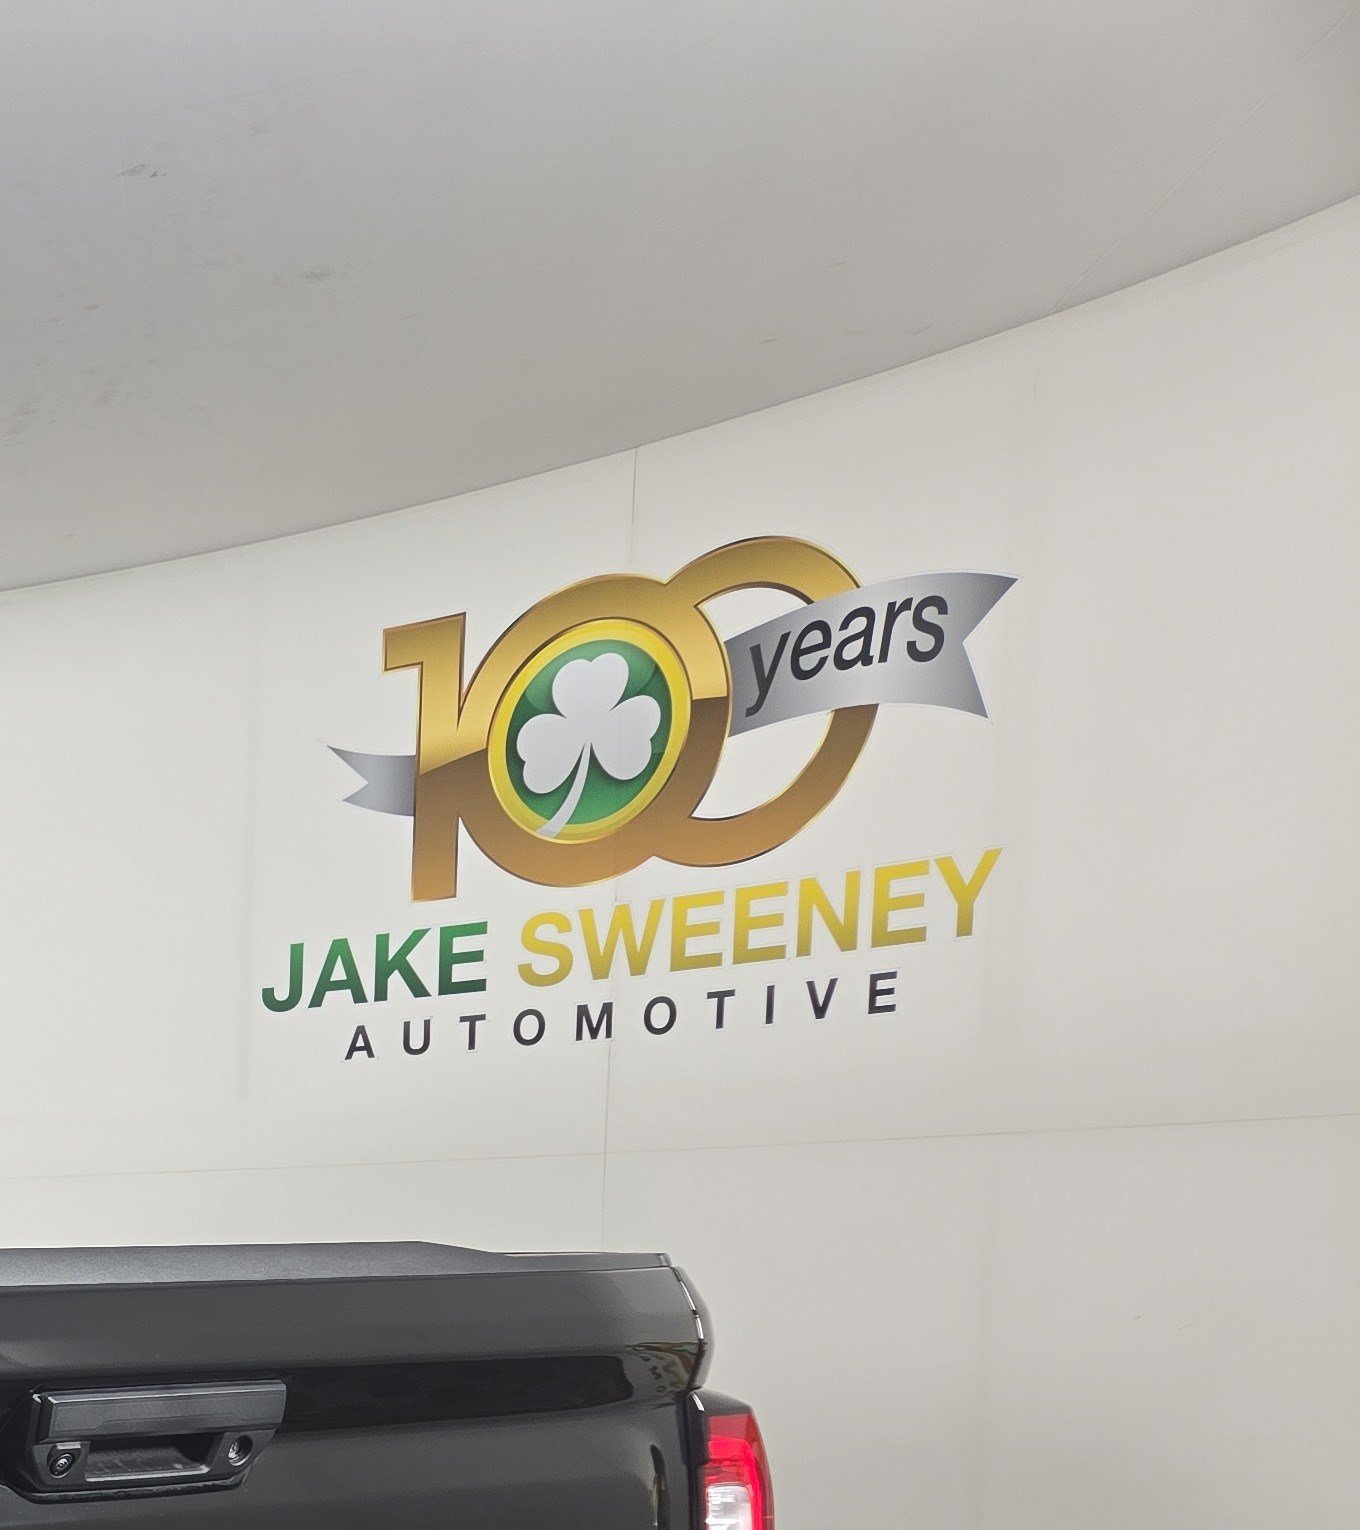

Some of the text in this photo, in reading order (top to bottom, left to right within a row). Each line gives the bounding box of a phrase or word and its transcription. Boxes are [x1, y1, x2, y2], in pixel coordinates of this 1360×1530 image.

[744, 592, 949, 718] years
[261, 847, 1004, 1014] JAKE SWEENEY
[344, 970, 898, 1062] AUTOMOTIVE
